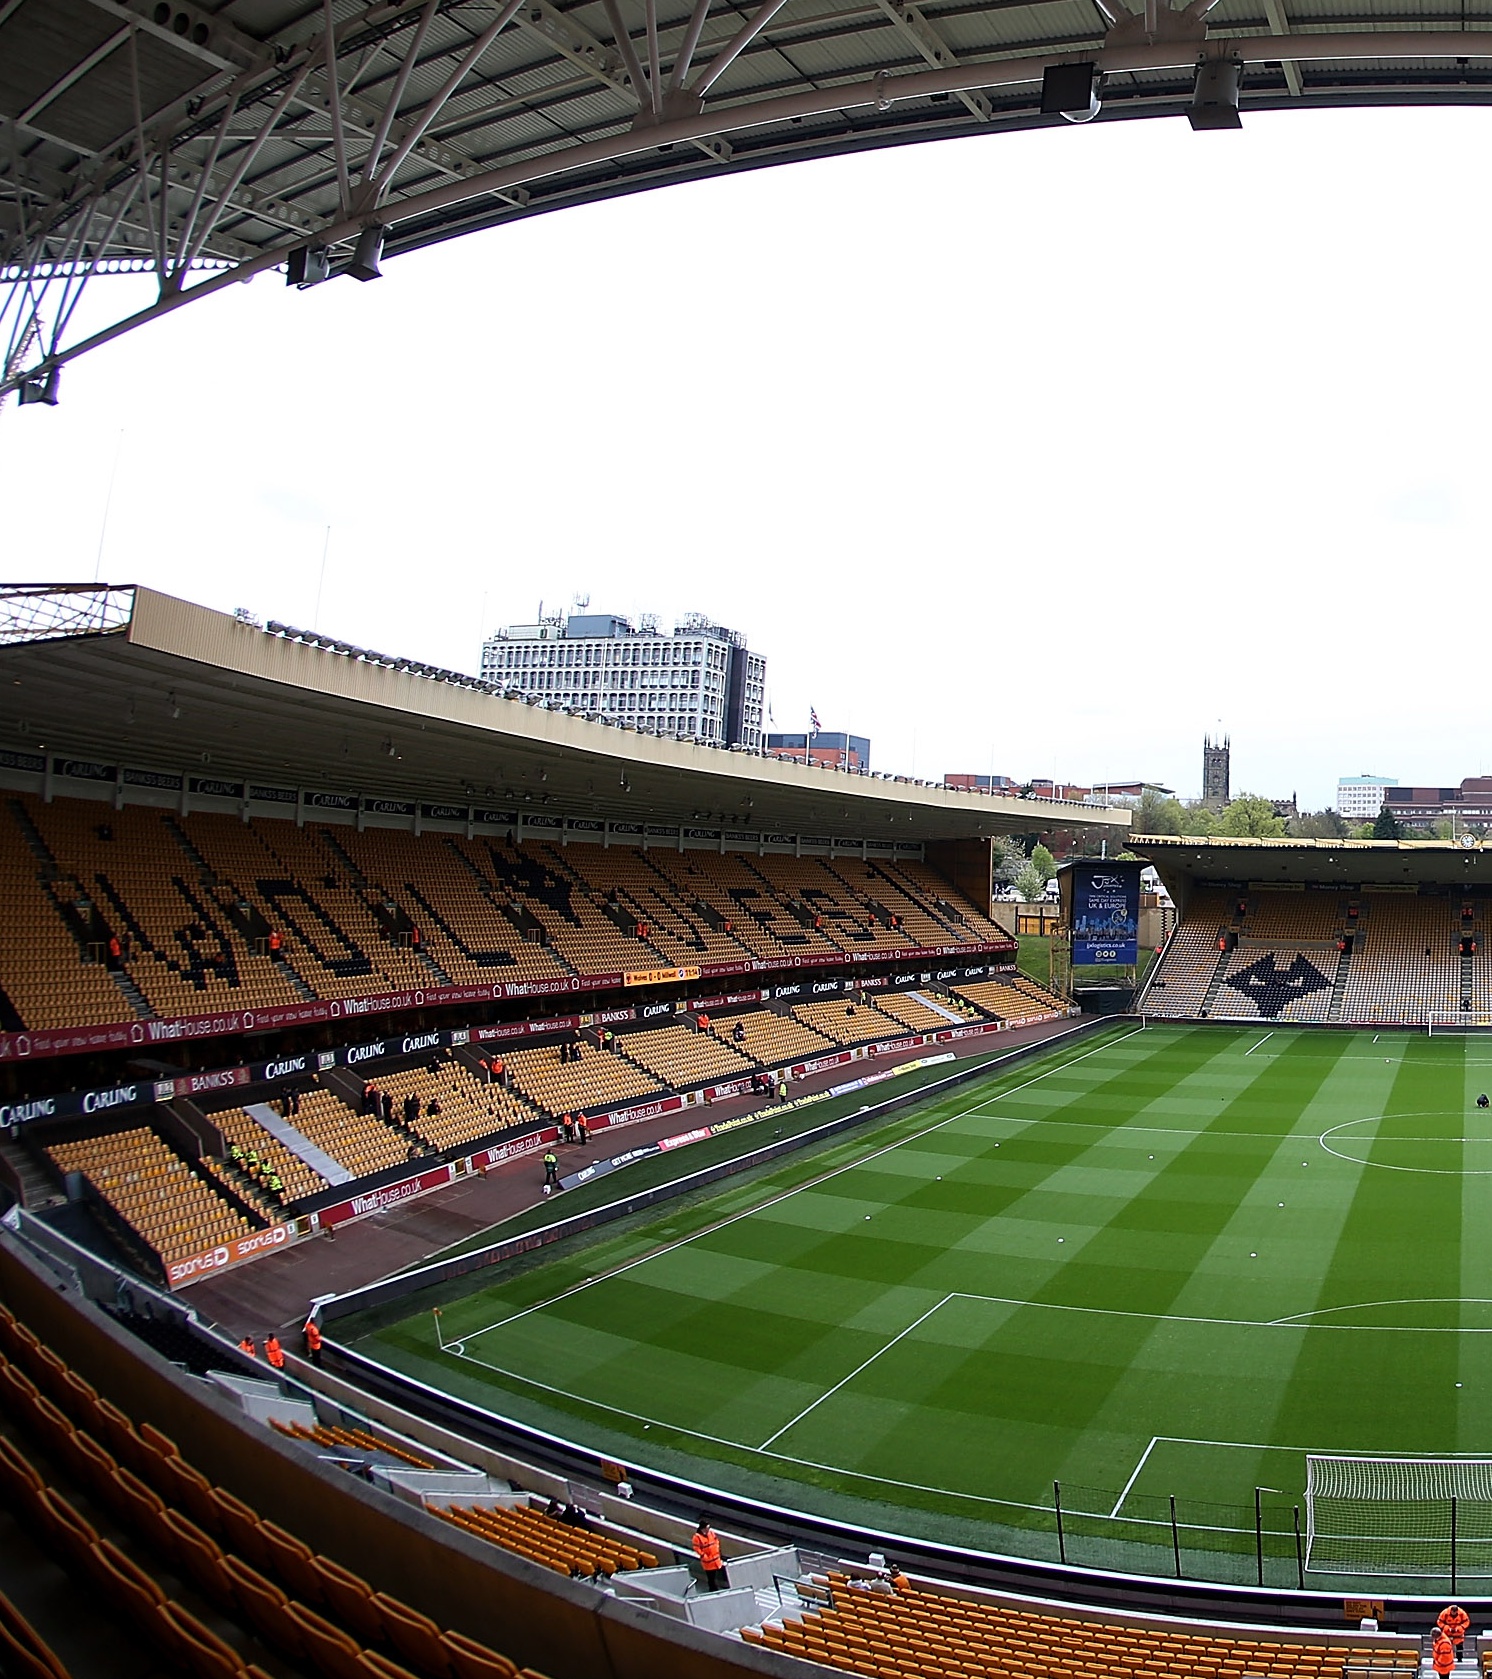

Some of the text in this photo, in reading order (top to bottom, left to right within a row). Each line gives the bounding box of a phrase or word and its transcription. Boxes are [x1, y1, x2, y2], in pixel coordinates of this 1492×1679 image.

[63, 760, 107, 778] CARLING
[157, 775, 181, 790] BEERS
[197, 779, 235, 795] CARLING
[312, 793, 350, 807] CARLING
[373, 800, 407, 813] CARLING
[430, 806, 460, 818] CARLING
[483, 811, 509, 822] CARLING
[528, 815, 556, 827] CARLING
[573, 820, 598, 830] CARLING
[613, 823, 639, 833] CARLING
[752, 958, 793, 971] WhatHouse.co.uk
[852, 951, 894, 963] WhatHouse.co.uk
[895, 974, 915, 985] CARLING
[937, 969, 957, 980] CARLING
[965, 967, 984, 977] CARLING
[505, 980, 569, 996] WhatHouse.co.uk
[775, 985, 800, 998] CARLING
[812, 981, 838, 993] CARLING
[343, 993, 412, 1015] WhatHouse.co.uk
[692, 993, 756, 1009] WhatHouse.co.uk WhatHouse.co.uk
[643, 1003, 670, 1018] CARLING
[149, 1014, 239, 1040] WhatHouse.co.uk
[478, 1018, 572, 1039] WhatHouse.co.uk WhatHouse.co.uk
[951, 1026, 984, 1038] WhatHouse.co.uk
[402, 1032, 440, 1053] CARLING
[876, 1038, 915, 1052] WhatHouse.co.uk
[347, 1042, 385, 1064] CARLING
[266, 1056, 306, 1080] CARLING
[804, 1056, 840, 1073] WhatHouse.co.uk
[83, 1085, 137, 1114] CARLING
[0, 1099, 55, 1128] CARLING
[608, 1104, 663, 1125] WhatHouse.co.uk
[664, 1134, 687, 1148] Express
[693, 1128, 706, 1140] Star
[487, 1133, 543, 1163] WhatHouse.co.uk
[351, 1178, 422, 1215] WhatHouse.co.uk
